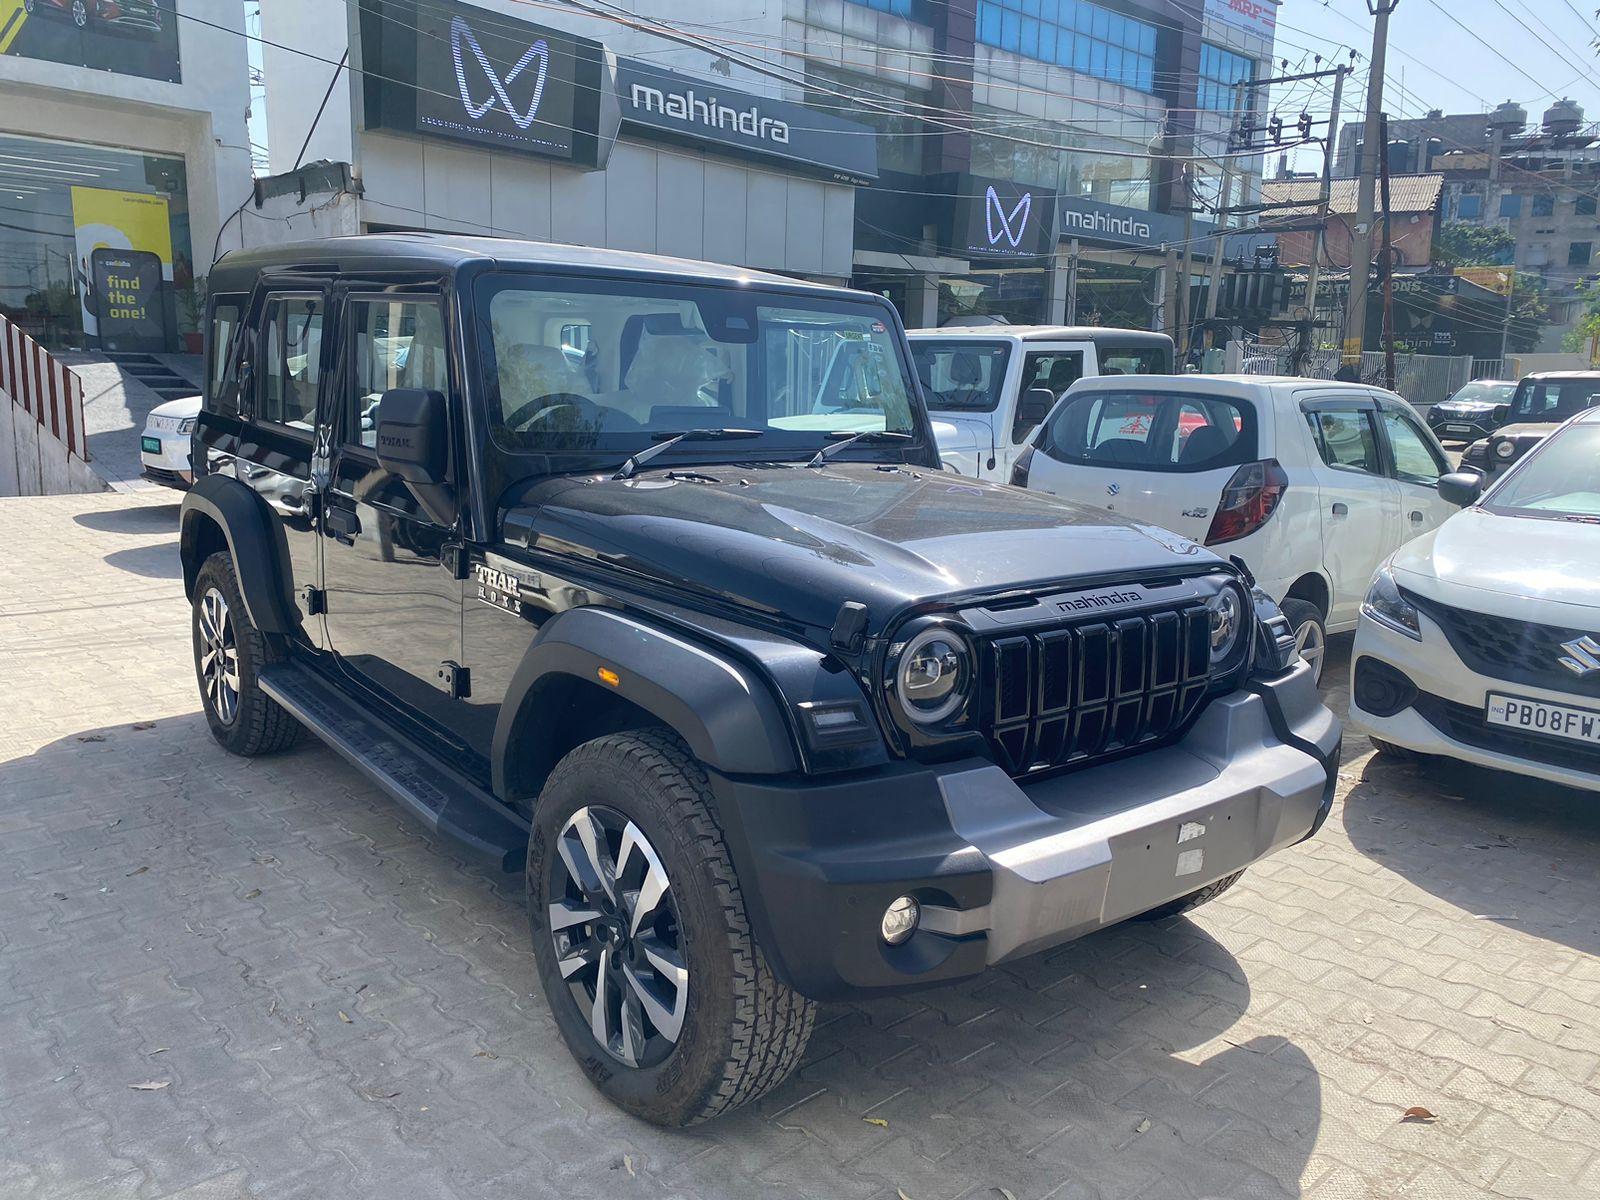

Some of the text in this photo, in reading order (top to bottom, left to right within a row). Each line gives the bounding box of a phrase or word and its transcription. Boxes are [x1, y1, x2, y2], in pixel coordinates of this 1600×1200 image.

[1228, 0, 1262, 19] MRF
[631, 83, 789, 145] mahindra
[1064, 209, 1151, 239] mahindra
[106, 275, 140, 290] find
[108, 291, 136, 305] the
[110, 308, 146, 320] one!
[475, 564, 521, 598] THAR
[478, 586, 521, 613] ROXX
[1056, 591, 1143, 612] mahindra
